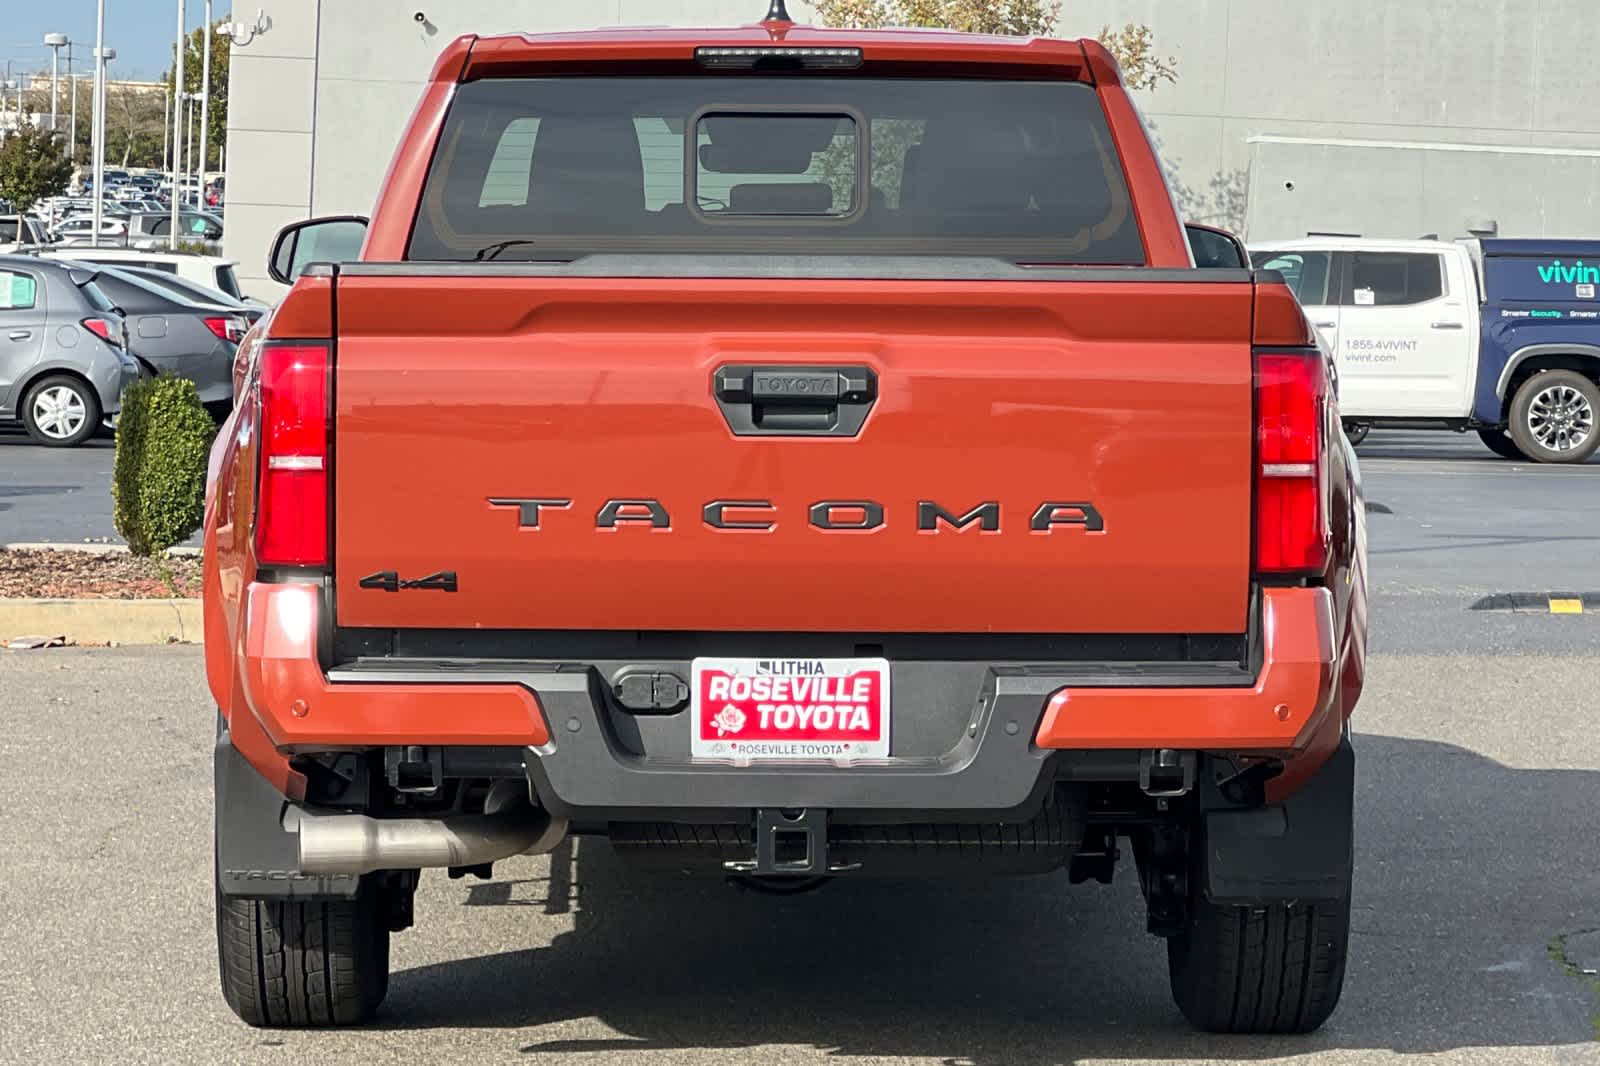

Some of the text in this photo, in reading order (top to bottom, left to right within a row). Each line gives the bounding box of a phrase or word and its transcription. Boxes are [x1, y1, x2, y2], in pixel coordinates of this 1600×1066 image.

[1537, 260, 1600, 284] vivin
[1345, 353, 1397, 362] vivint.com
[757, 377, 832, 391] TOYOTA
[487, 498, 1107, 535] TACOMA
[771, 661, 825, 675] LITHIA
[708, 676, 872, 702] ROSEVILLE
[756, 704, 870, 730] TOYOTA
[738, 744, 843, 755] ROSEVILLE TOYOTA
